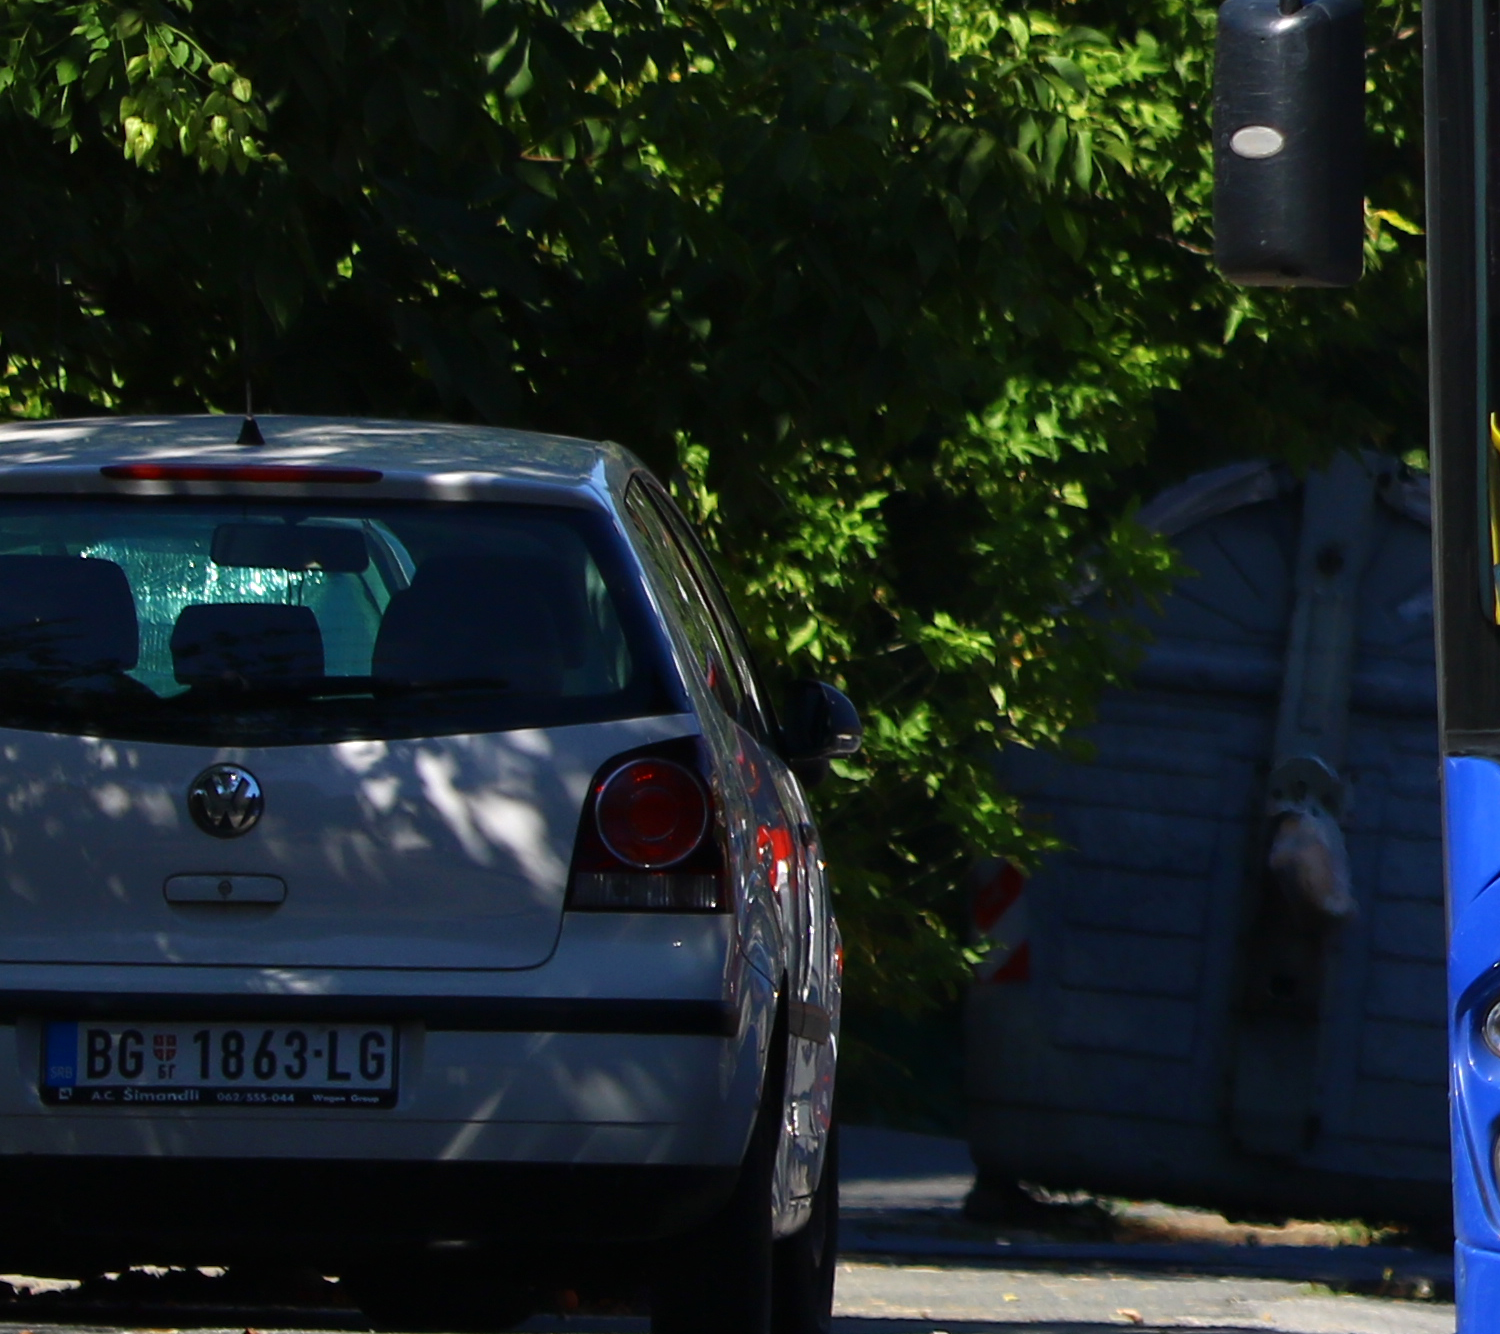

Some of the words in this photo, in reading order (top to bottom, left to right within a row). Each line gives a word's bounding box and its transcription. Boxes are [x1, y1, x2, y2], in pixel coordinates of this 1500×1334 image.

[86, 1028, 144, 1080] BG
[50, 1066, 73, 1079] SRB
[123, 1087, 200, 1101] Šimandli
[217, 1093, 295, 1104] 062/555-044
